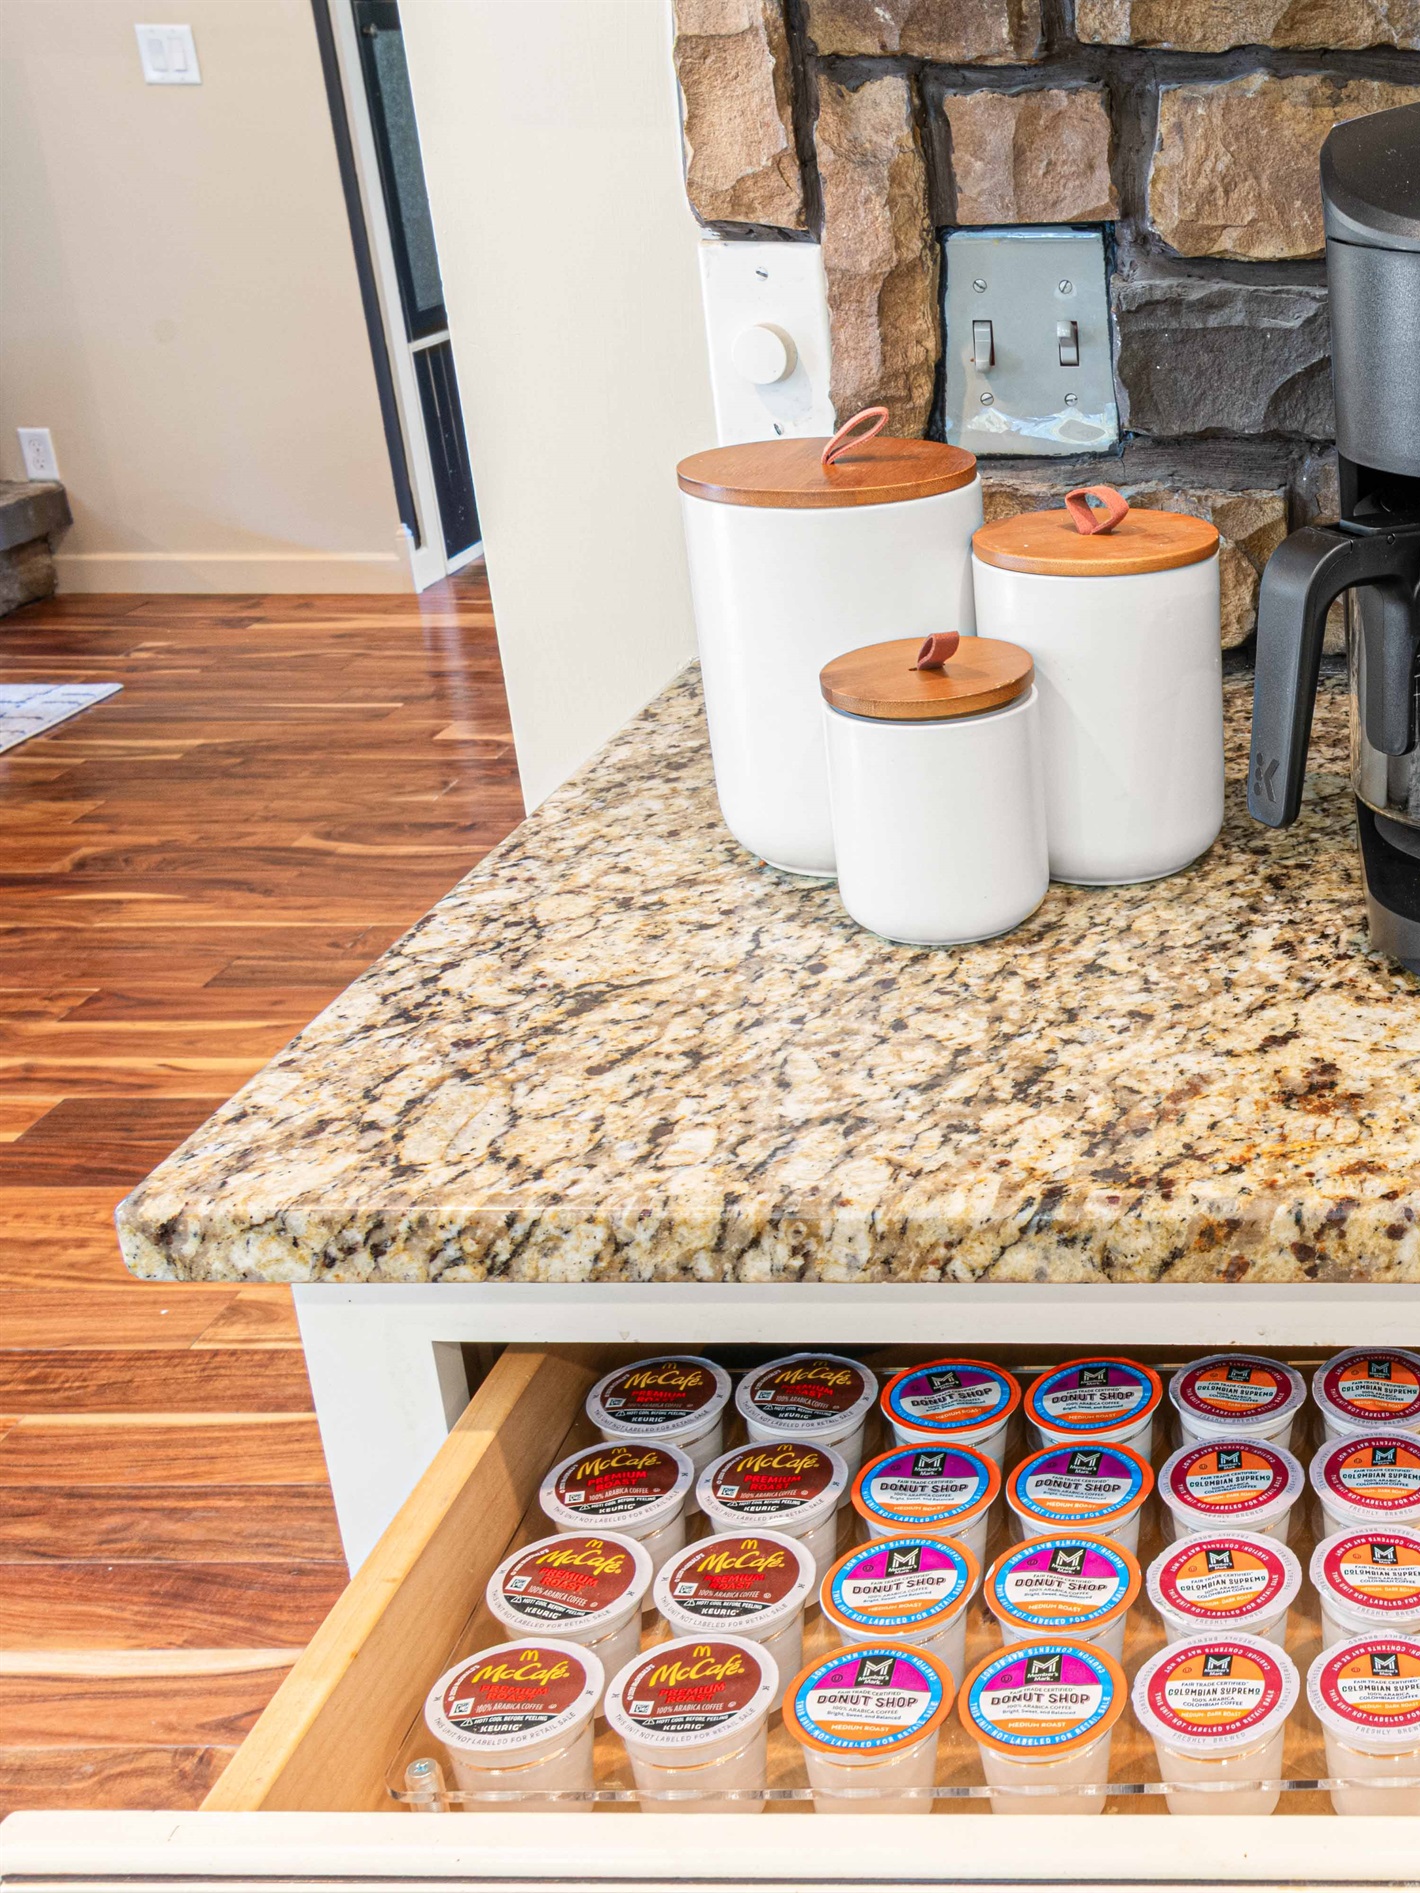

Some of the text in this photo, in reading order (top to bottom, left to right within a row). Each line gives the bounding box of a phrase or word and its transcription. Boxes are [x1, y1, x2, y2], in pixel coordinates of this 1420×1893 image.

[586, 1470, 648, 1487] PREMIUM
[743, 1474, 802, 1483] PREMIUM
[1189, 1478, 1233, 1488] COLOMBIAN
[595, 1478, 639, 1492] ROAST
[749, 1482, 791, 1491] ROAST
[880, 1482, 969, 1493] DONUT SHOP
[1035, 1478, 1122, 1493] DONUT SHOP
[599, 1504, 635, 1514] KEURIG
[539, 1567, 599, 1587] PREMIUM
[703, 1573, 766, 1582] PREMIUM
[1344, 1569, 1390, 1577] COLOMBIAN
[540, 1576, 586, 1592] ROAST
[709, 1580, 754, 1590] ROAST
[852, 1577, 947, 1595] DONUT SHOP
[1014, 1578, 1108, 1592] DONUT SHOP
[1180, 1579, 1227, 1591] COLOMBIAN
[524, 1606, 559, 1619] KEURIG
[701, 1607, 737, 1616] KEURIG
[479, 1684, 550, 1696] PREMIUM
[659, 1681, 726, 1697] PREMIUM
[1168, 1687, 1261, 1697] COLOMBIAN SUPREMO
[1341, 1684, 1391, 1693] COLOMBIAN
[485, 1693, 536, 1702] ROAST
[665, 1693, 715, 1704] ROAST
[817, 1695, 919, 1708] DONUT SHOP
[991, 1693, 1091, 1706] DONUT SHOP
[479, 1724, 520, 1733] KEURIG
[830, 1724, 863, 1732] MEDIUM
